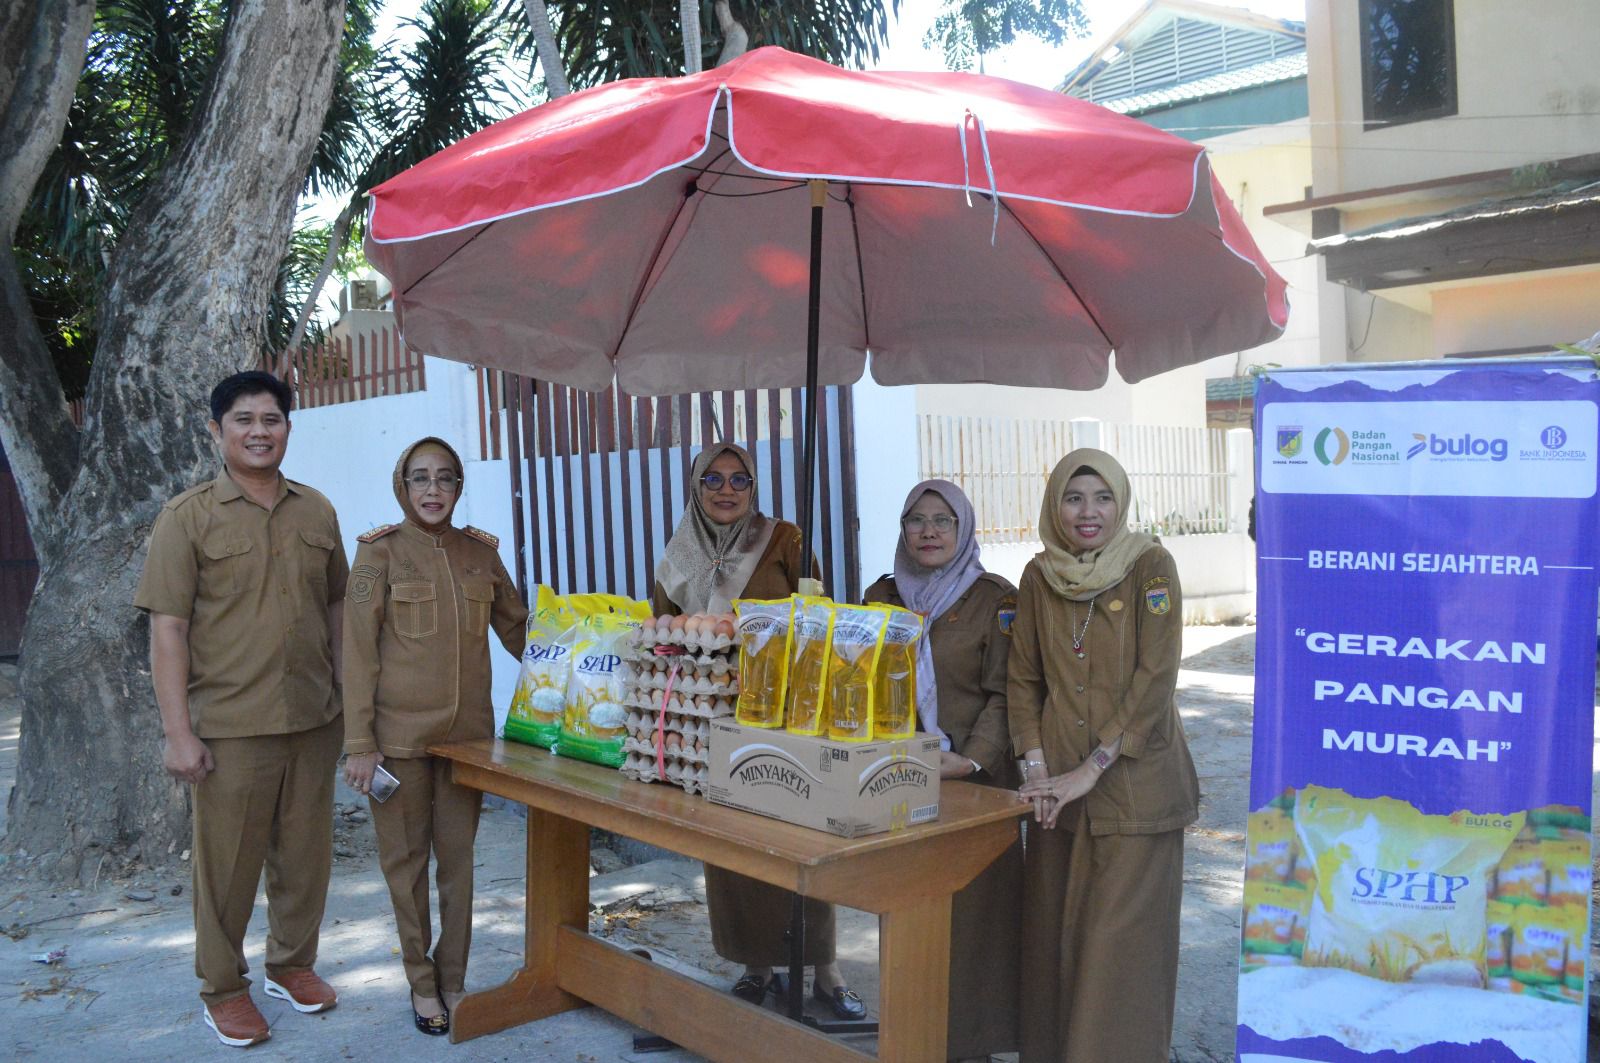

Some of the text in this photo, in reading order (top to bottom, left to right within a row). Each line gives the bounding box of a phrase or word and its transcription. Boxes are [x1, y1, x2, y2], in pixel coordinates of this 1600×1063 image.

[1352, 430, 1386, 440] Badan
[1352, 441, 1392, 451] Pangan
[1430, 433, 1508, 462] bulog
[1352, 452, 1400, 461] Nasional
[1543, 450, 1587, 458] INDONESIA
[1308, 550, 1539, 576] BERANI SEJAHTERA
[1295, 627, 1546, 665] “GERAKAN
[1314, 679, 1523, 714] PANGAN
[1322, 728, 1512, 762] MURAH”
[739, 764, 811, 800] MINYAKITA
[868, 768, 928, 797] MINYAKITA
[1465, 816, 1513, 829] BULOG
[1352, 866, 1469, 904] SPHP
